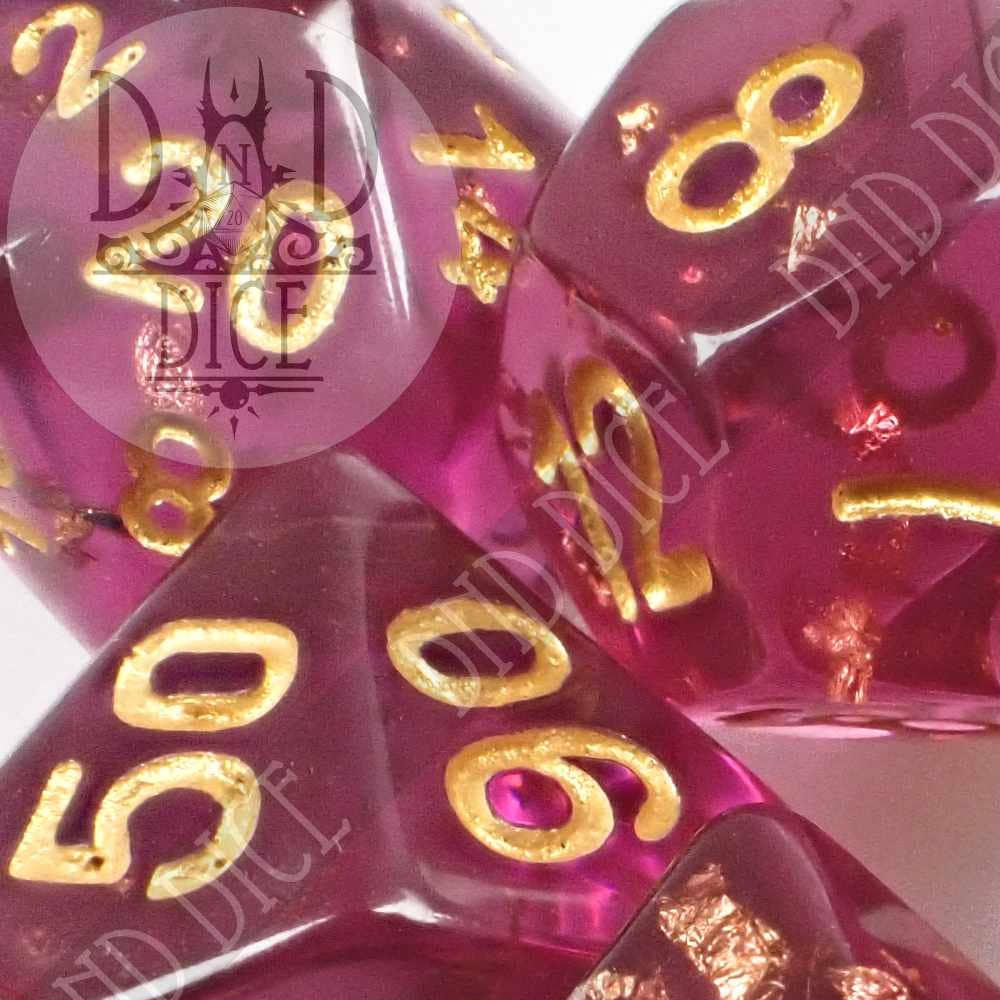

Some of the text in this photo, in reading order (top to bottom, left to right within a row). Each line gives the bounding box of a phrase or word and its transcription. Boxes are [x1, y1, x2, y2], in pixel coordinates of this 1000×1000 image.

[12, 3, 146, 118] 2
[645, 44, 864, 234] 8
[83, 140, 354, 354] 20
[7, 618, 299, 902] 50
